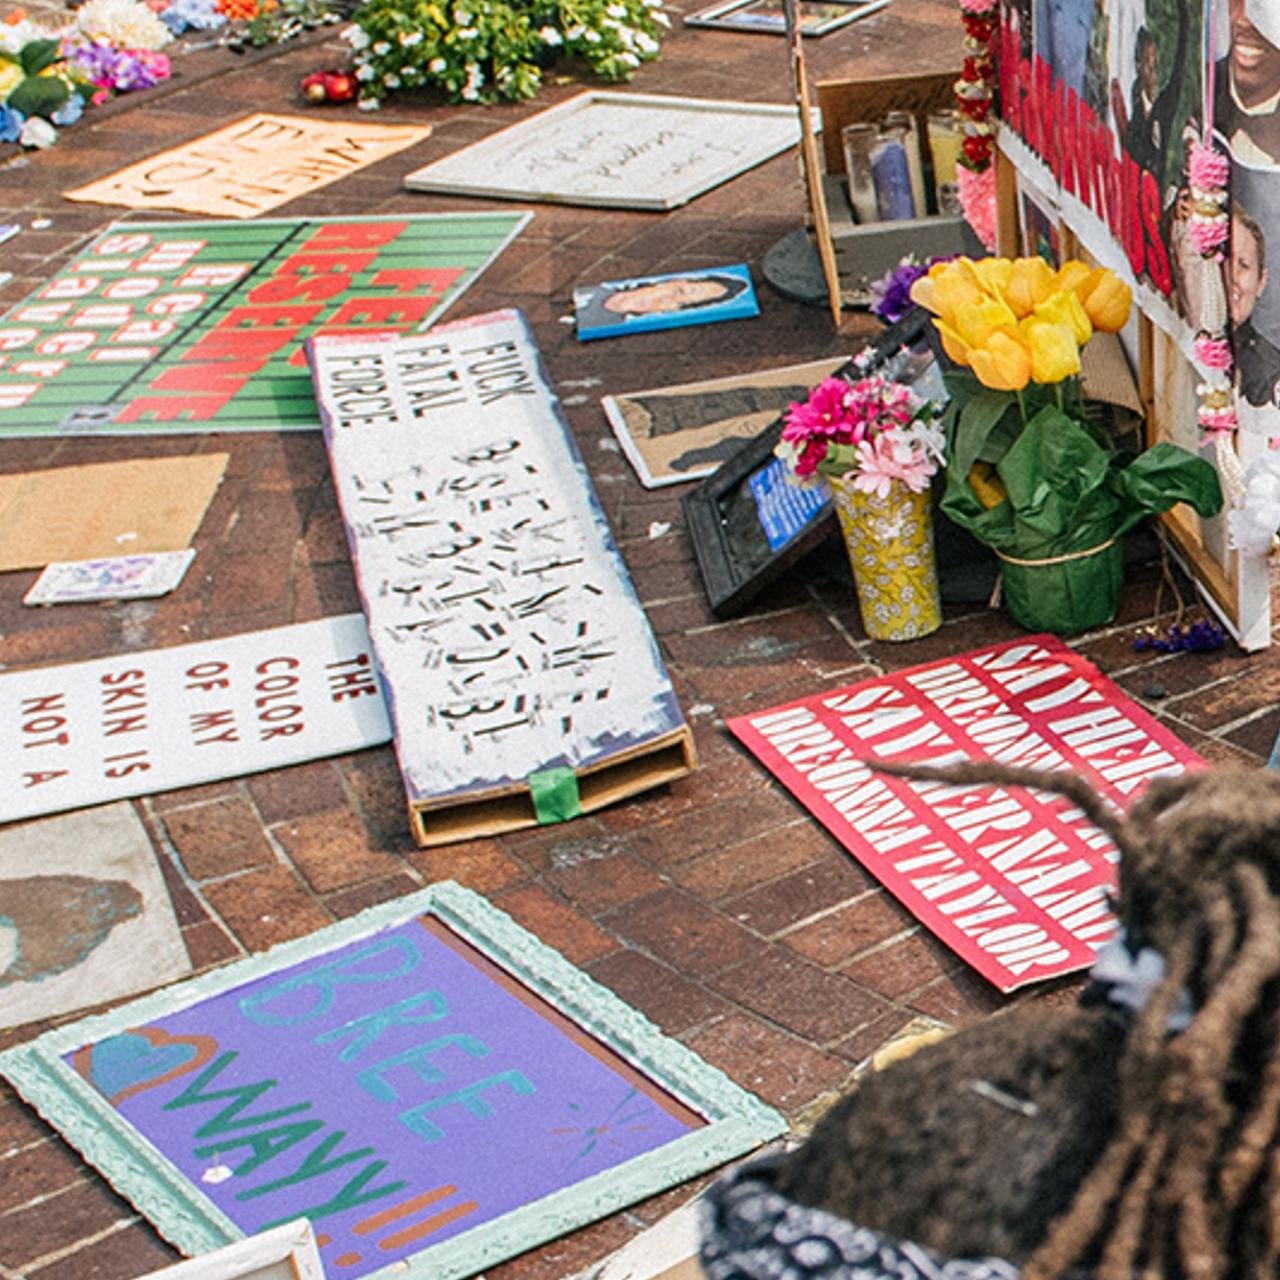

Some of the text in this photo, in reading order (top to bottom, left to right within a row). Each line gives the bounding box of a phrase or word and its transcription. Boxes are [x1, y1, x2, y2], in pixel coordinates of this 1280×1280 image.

[112, 221, 410, 424] RESERVE
[326, 354, 399, 428] FORCE
[394, 343, 468, 418] FATAL
[459, 339, 537, 406] FUCK
[185, 661, 240, 746] OF MY
[255, 656, 304, 742] COLOR
[326, 653, 377, 704] THE
[821, 685, 954, 757] SAY
[971, 643, 1187, 796] SAY HER
[21, 693, 70, 789] NOT A
[100, 668, 151, 779] SKIN IS
[749, 706, 1072, 978] BREONNA TAYLOR
[237, 935, 537, 1143] BREE
